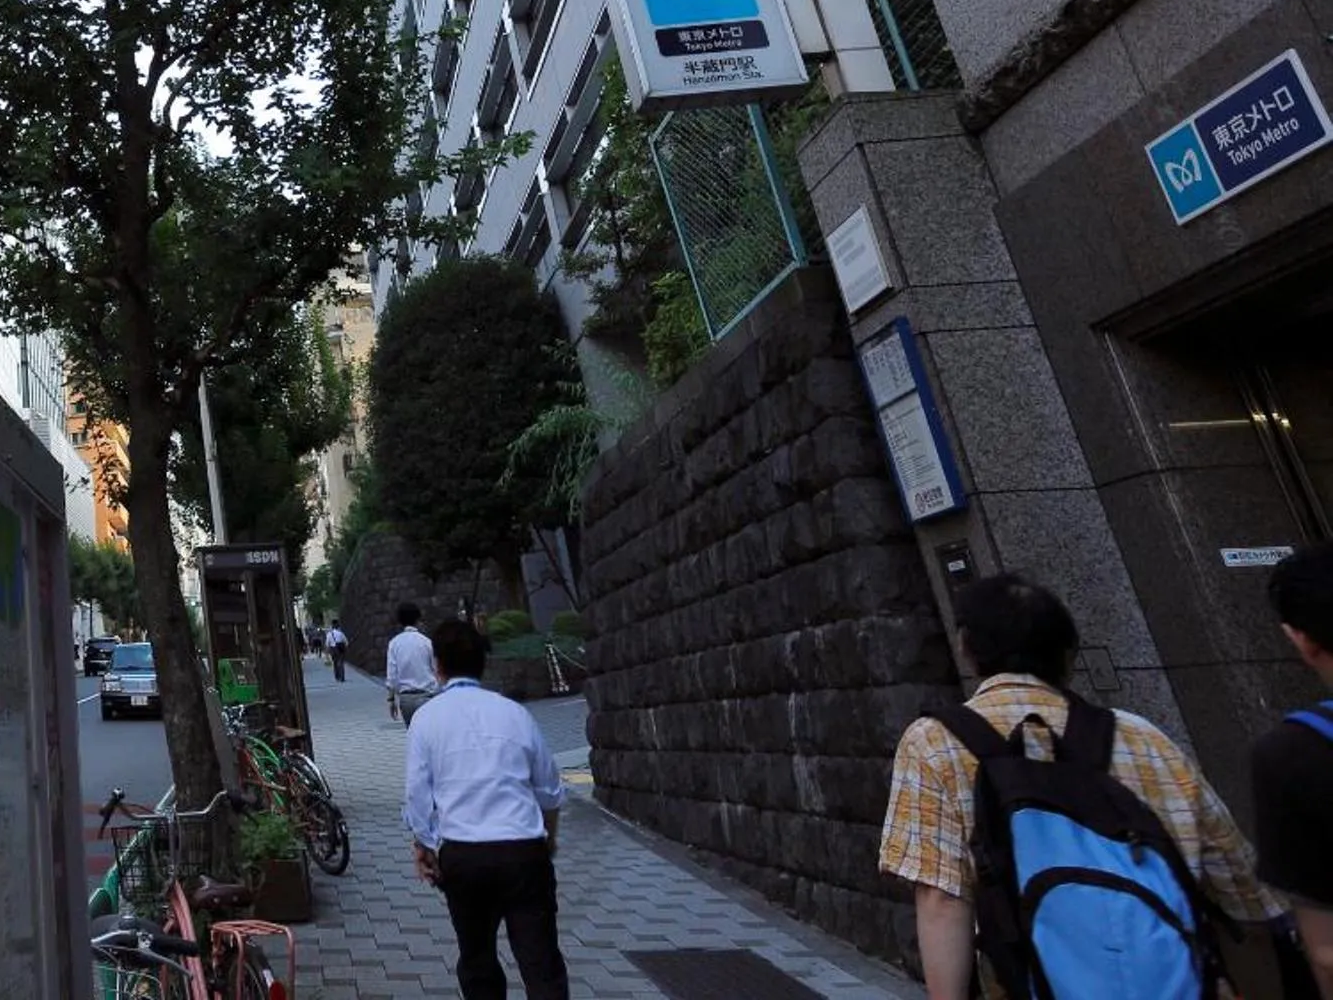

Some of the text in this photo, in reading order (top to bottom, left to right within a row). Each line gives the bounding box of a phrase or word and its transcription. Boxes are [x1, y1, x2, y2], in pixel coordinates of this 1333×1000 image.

[677, 26, 744, 43] 東京メトロ
[685, 39, 743, 52] Tokyo Metro
[684, 55, 756, 75] 半蔵門駅
[1212, 85, 1295, 151] 東京メトロ
[1227, 117, 1300, 166] Tokyo Metro
